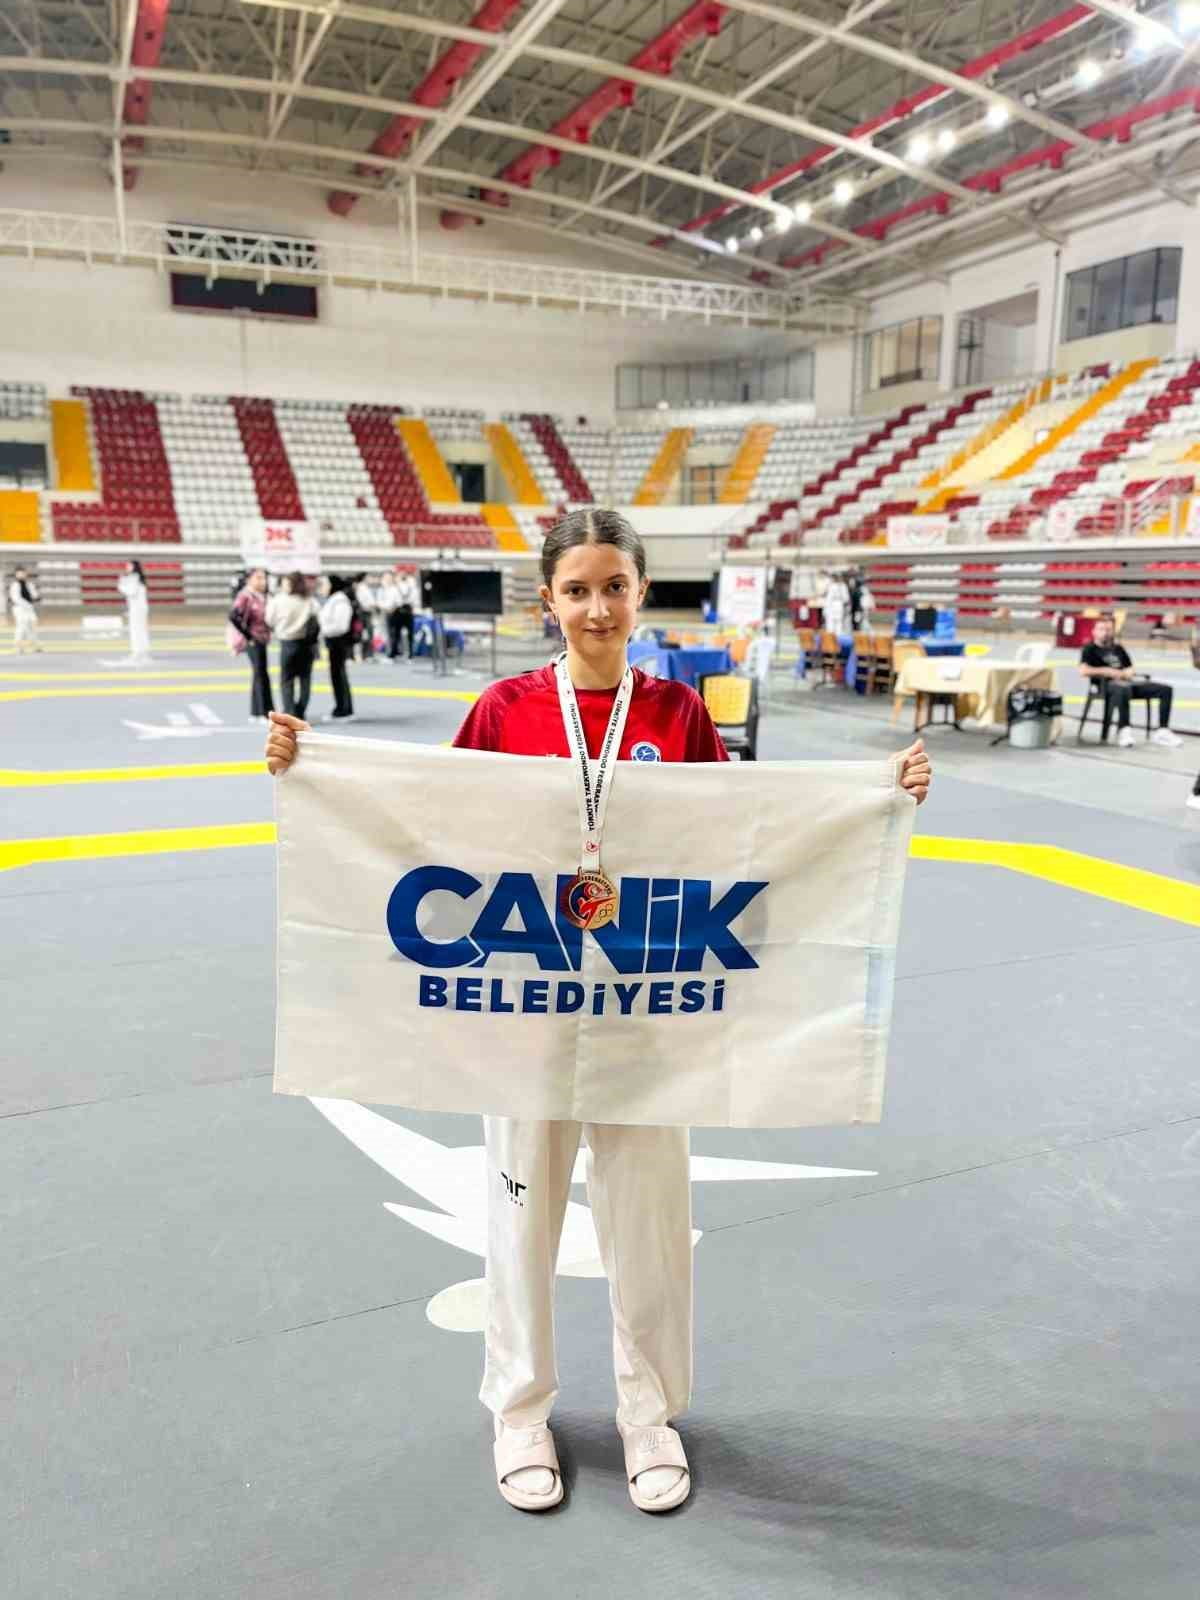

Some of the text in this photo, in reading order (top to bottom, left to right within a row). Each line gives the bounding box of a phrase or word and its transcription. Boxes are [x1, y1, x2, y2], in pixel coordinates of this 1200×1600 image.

[601, 728, 616, 769] TAEKWONDO
[580, 751, 591, 797] TAEKWONDO
[386, 865, 770, 974] CANİK
[418, 974, 726, 1016] BELEDİYESİ
